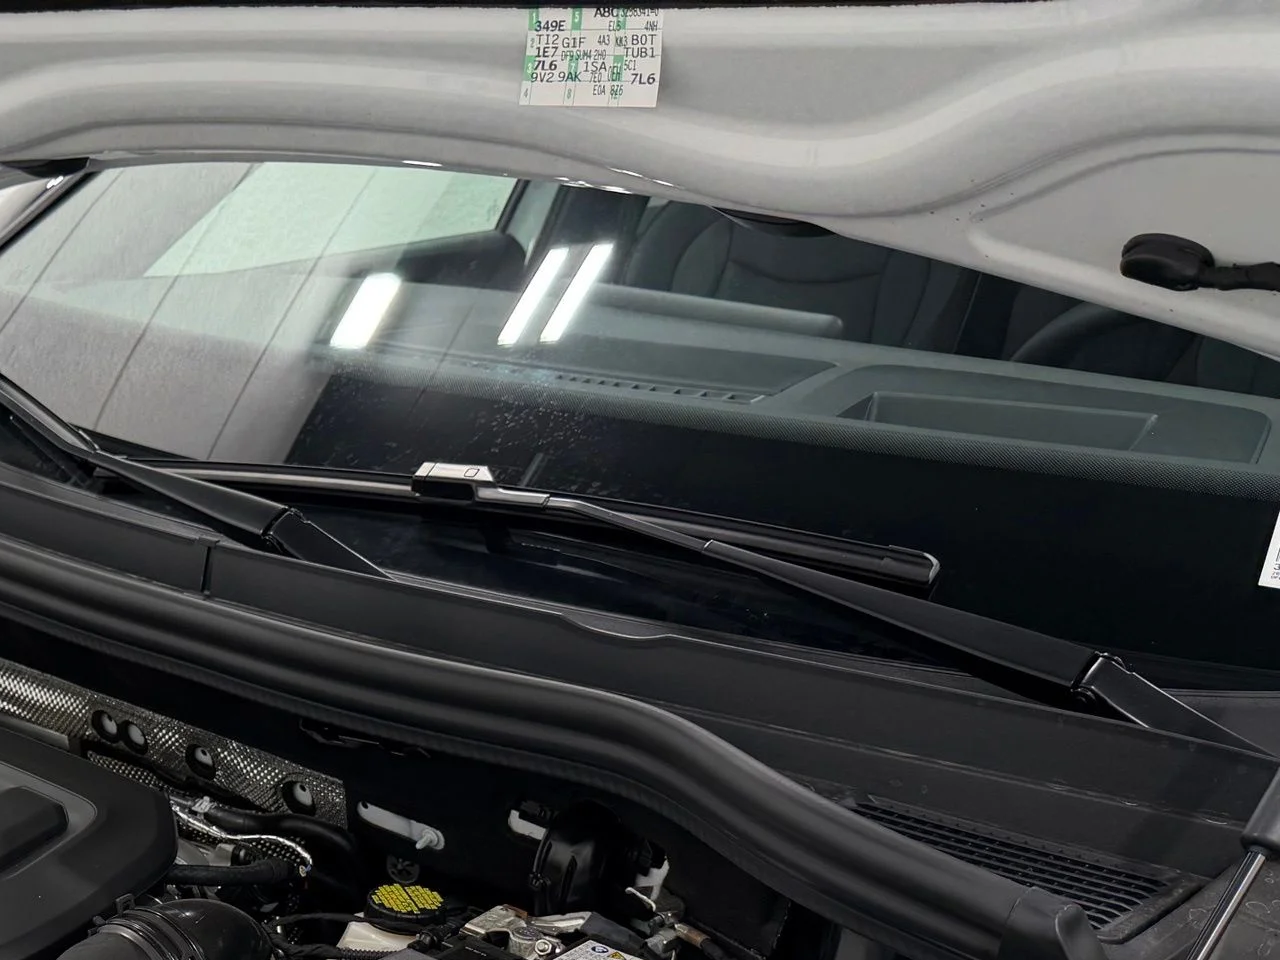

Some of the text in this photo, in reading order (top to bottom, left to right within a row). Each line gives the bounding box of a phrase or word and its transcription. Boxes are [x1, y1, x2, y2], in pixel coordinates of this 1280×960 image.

[534, 20, 566, 32] 349E
[535, 46, 559, 58] 1E7
[533, 59, 558, 71] 7L6
[530, 71, 582, 83] 9V2 9AK
[630, 72, 656, 85] 7L6
